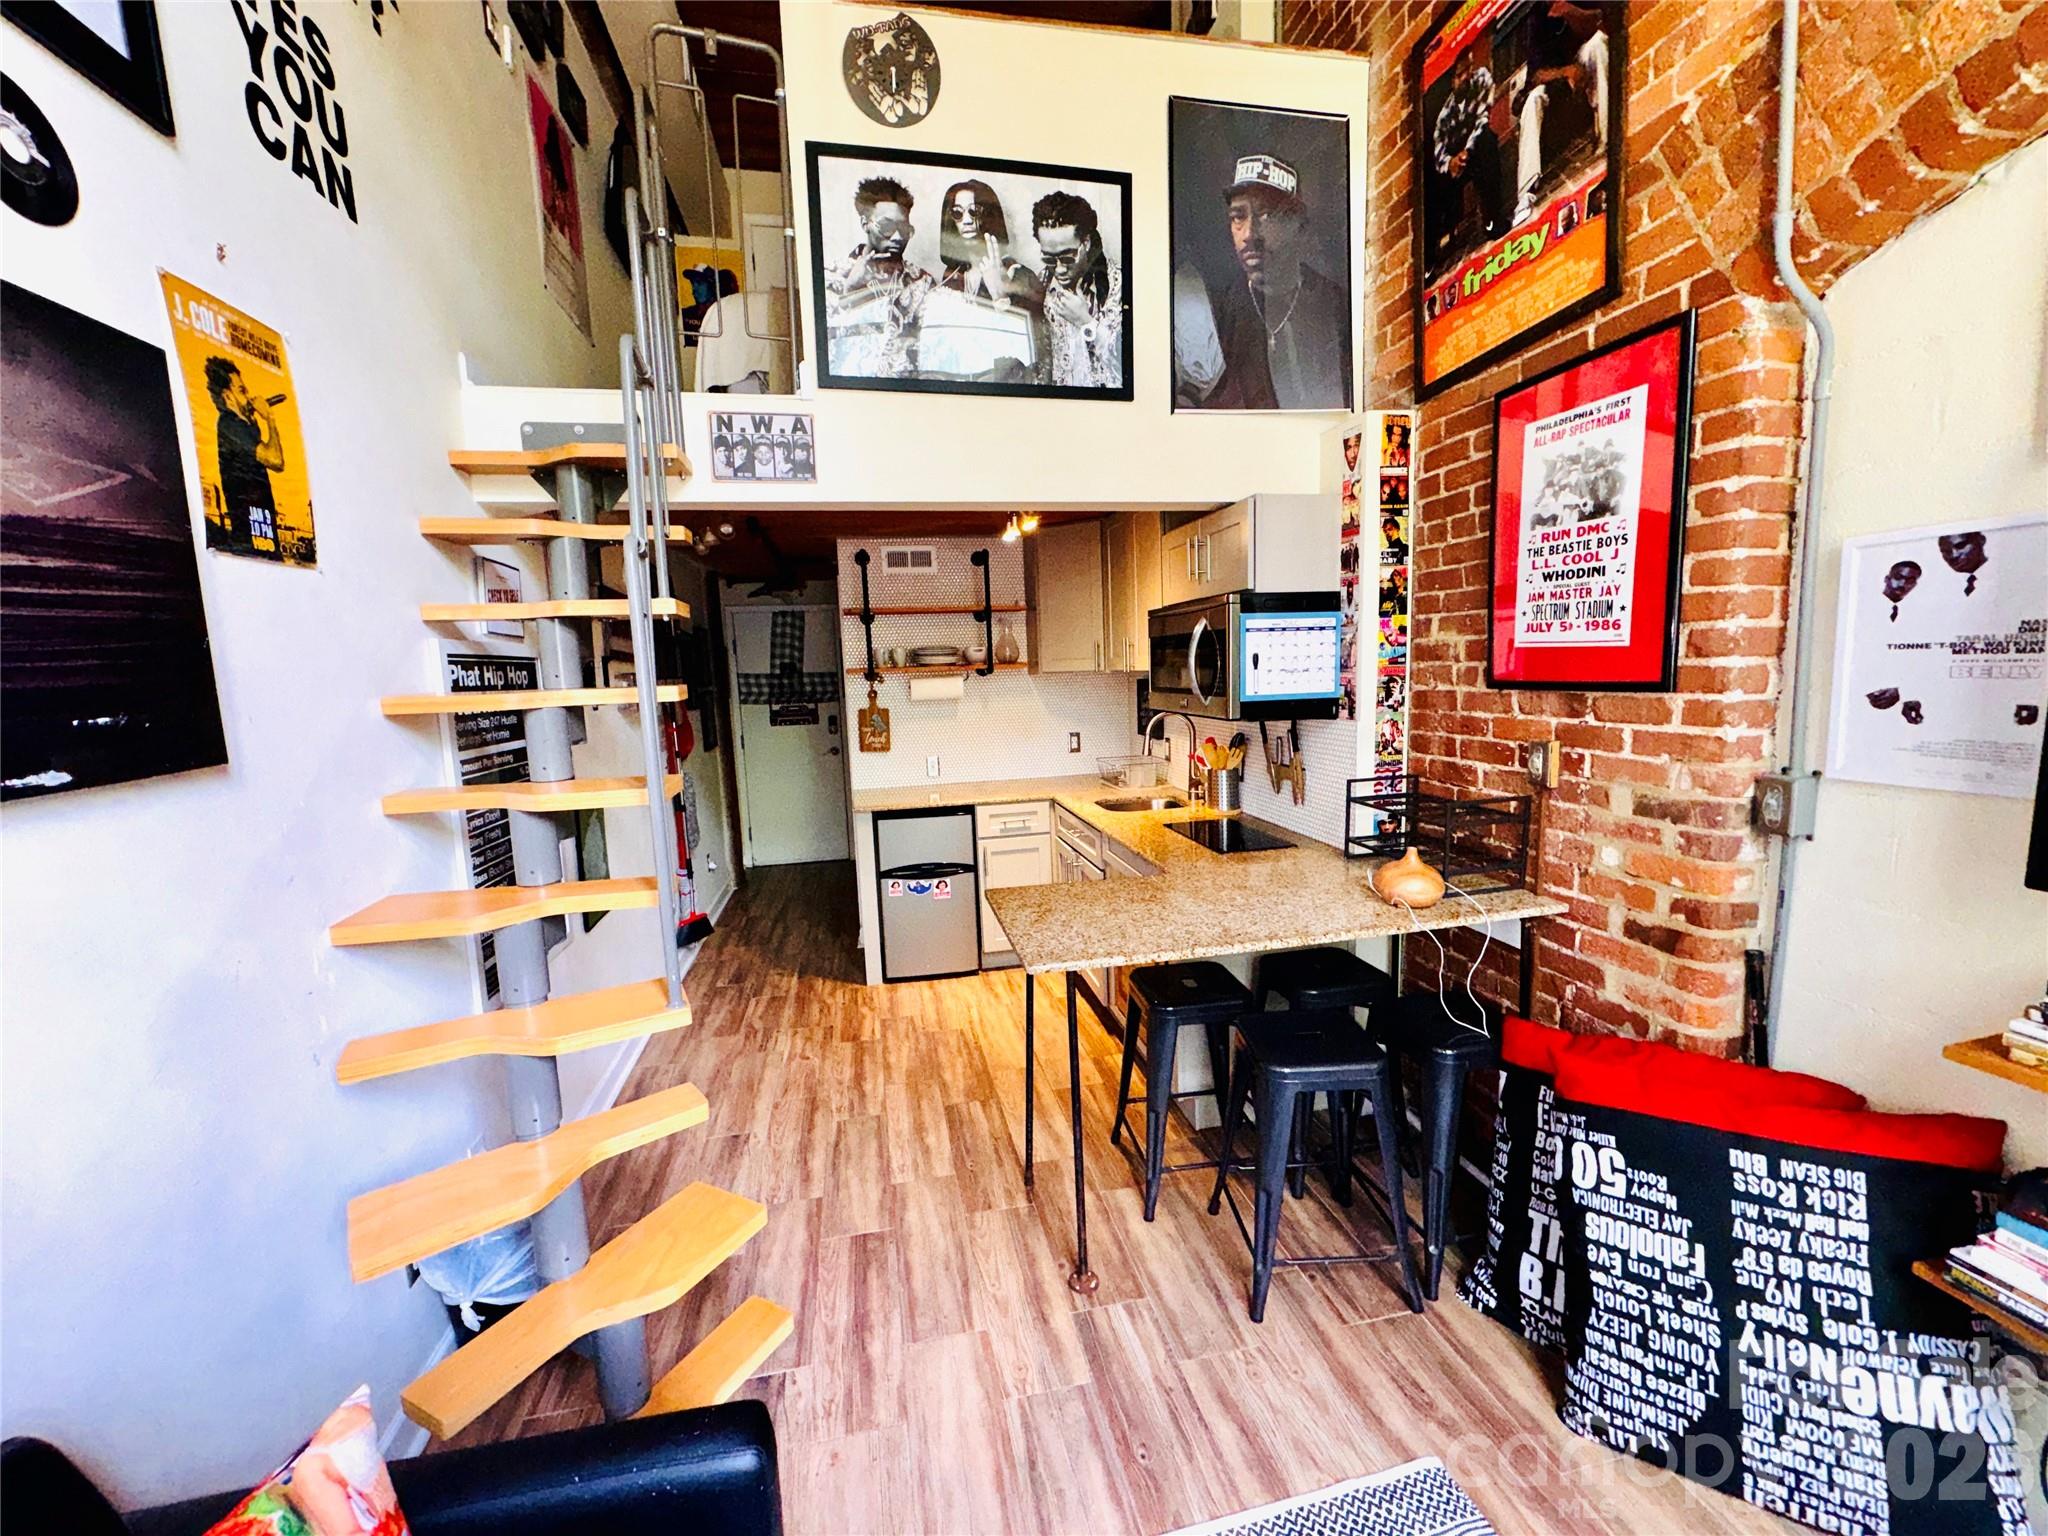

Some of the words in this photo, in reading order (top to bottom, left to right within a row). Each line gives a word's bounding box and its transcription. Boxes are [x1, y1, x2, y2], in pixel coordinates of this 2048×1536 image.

[246, 0, 335, 90] ES
[230, 0, 348, 157] YOU
[245, 81, 358, 224] CAN
[1463, 222, 1550, 297] friday
[173, 292, 190, 325] J.
[189, 300, 229, 345] COLE
[1534, 428, 1566, 449] ALL-RAP
[1569, 408, 1631, 437] SPECTACULAR
[1535, 405, 1601, 433] PHILADELPHIA'S
[1605, 396, 1632, 412] FIRST
[1527, 546, 1545, 558] THE
[1548, 539, 1591, 556] BEASTIE
[1597, 533, 1628, 549] BOYS
[1541, 528, 1571, 544] RUN
[1576, 522, 1610, 538] DMC
[1532, 559, 1555, 570] L.L.
[1562, 551, 1603, 566] COOL
[1610, 548, 1618, 560] J
[1542, 565, 1606, 582] WHODINI
[1527, 591, 1545, 603] JAM
[1550, 587, 1592, 600] MASTER
[1599, 584, 1621, 597] JAY
[1531, 603, 1569, 621] SPECTRUM
[1575, 600, 1613, 619] STADIUM
[1524, 622, 1553, 633] JULY
[1585, 619, 1621, 631] 1986
[1956, 634, 1996, 642] TARAL
[448, 664, 481, 687] Phat
[483, 665, 504, 689] Hip
[507, 665, 528, 688] Hop
[1950, 665, 2042, 679] BELLY
[1571, 1141, 1627, 1199] 50
[1627, 1167, 1667, 1192] Roots
[1729, 1148, 1767, 1177] Blu
[1780, 1158, 1830, 1188] SEAN
[1631, 1183, 1677, 1211] Nappy
[1732, 1172, 1797, 1209] Ross
[1834, 1167, 1867, 1195] BIG
[1572, 1187, 1659, 1231] ELECTRONICA
[1730, 1199, 1759, 1220] Mill
[1804, 1185, 1867, 1221] Rick
[1662, 1213, 1692, 1239] JAY
[1731, 1217, 1792, 1253] Zeeky
[1585, 1211, 1706, 1279] Fabolous
[1587, 1244, 1622, 1277] Eve
[1798, 1231, 1869, 1268] Freaky
[1778, 1255, 1803, 1280] da
[1807, 1260, 1873, 1297] Royce
[1593, 1286, 1651, 1326] Louch
[1734, 1268, 1801, 1311] N9ne
[1812, 1285, 1876, 1328] Tech
[1588, 1307, 1643, 1344] JEEZY
[1735, 1300, 1747, 1320] P
[1750, 1302, 1809, 1336] Styles
[1656, 1308, 1721, 1348] Sheek
[1822, 1318, 1879, 1352] Cole
[1585, 1345, 1642, 1387] Rascal
[1648, 1328, 1720, 1375] YOUNG
[1738, 1321, 1838, 1386] Nelly
[1645, 1374, 1706, 1411] Dizzee
[1738, 1359, 1790, 1395] Daddy
[1604, 1387, 1689, 1437] JERMAINE
[1741, 1383, 1783, 1415] CUDI
[1743, 1403, 1773, 1430] KID
[1786, 1416, 1845, 1449] DOOM
[1742, 1437, 1828, 1483] Property
[1849, 1434, 1884, 1459] MF
[1799, 1474, 1840, 1505] PREZ
[1832, 1467, 1888, 1500] State
[1844, 1489, 1889, 1518] DEAD
